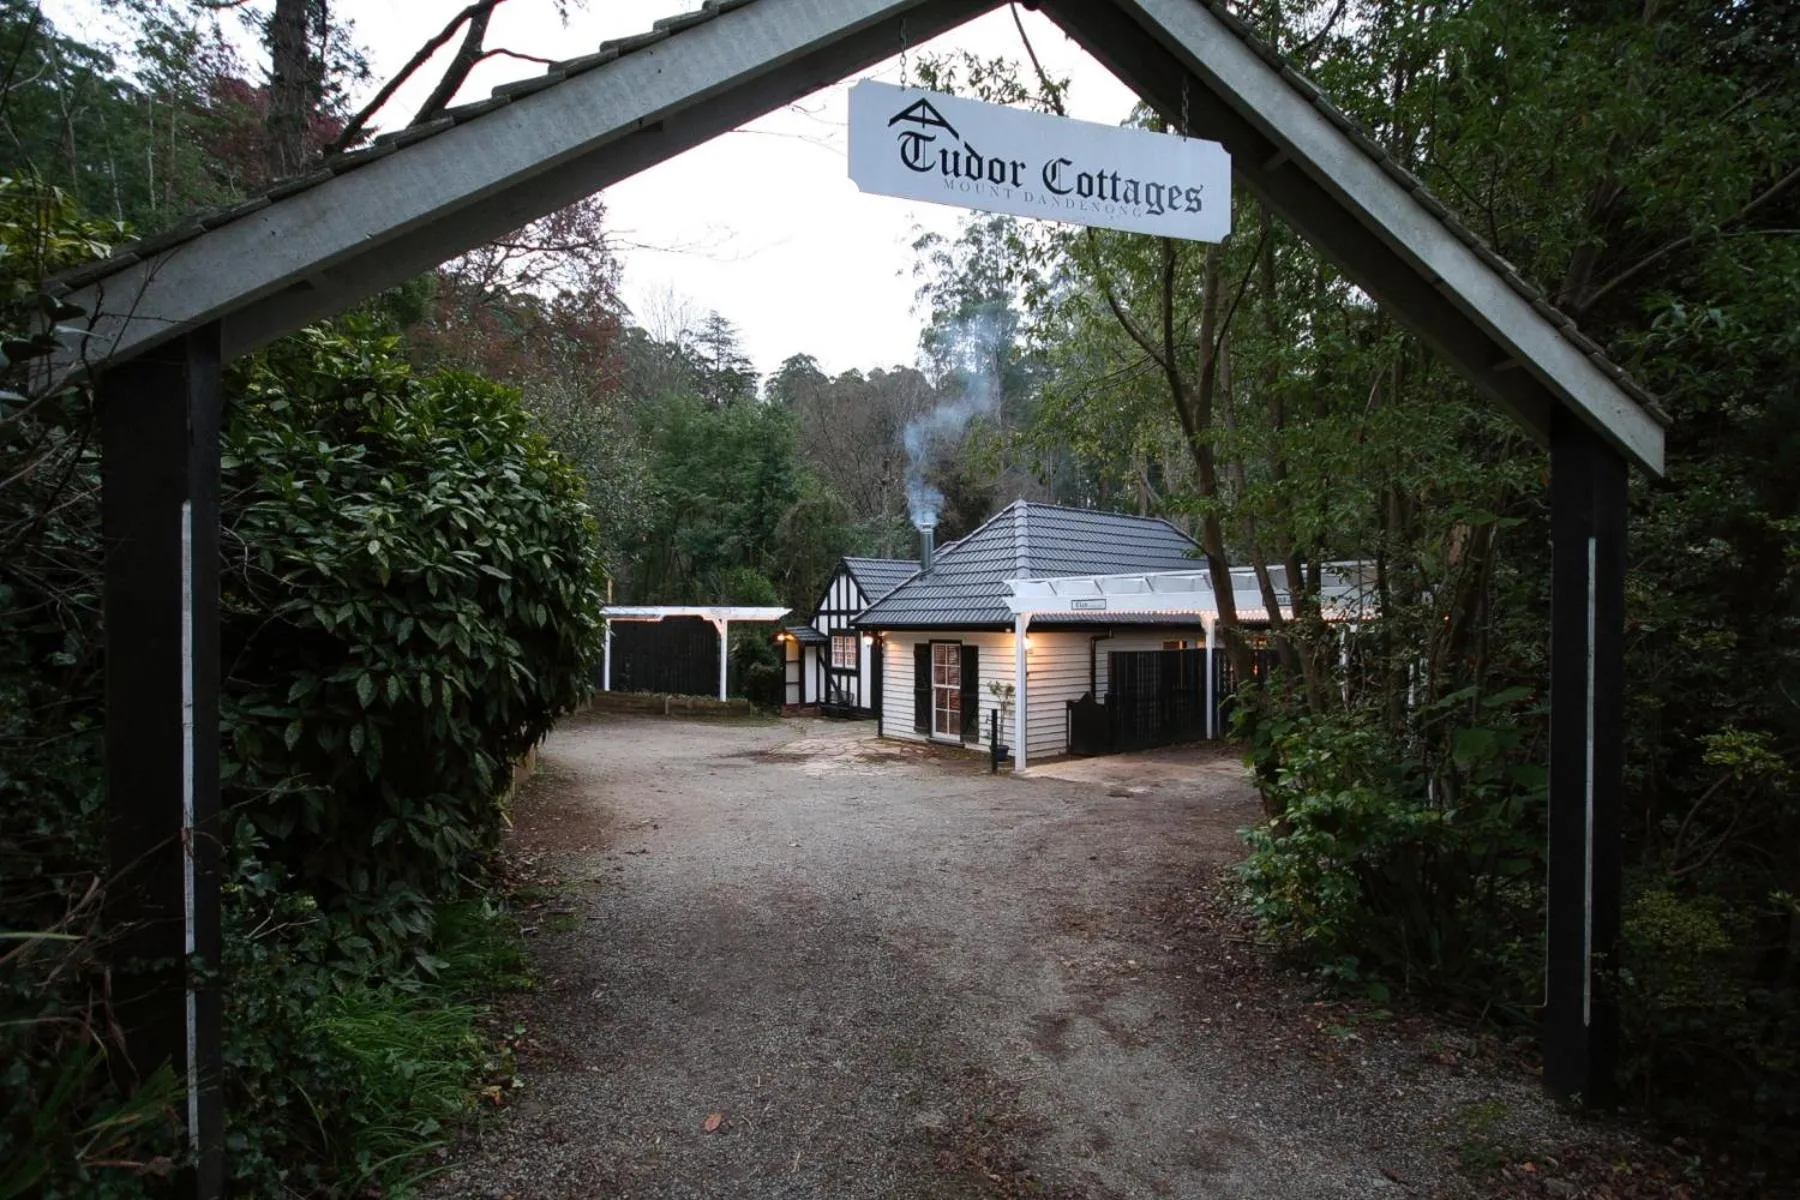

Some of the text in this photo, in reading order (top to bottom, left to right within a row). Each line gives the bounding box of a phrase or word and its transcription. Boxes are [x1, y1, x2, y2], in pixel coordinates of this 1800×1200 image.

[898, 131, 1204, 215] Tudor Cottages
[943, 178, 1142, 218] MOUNT DANDENONG
